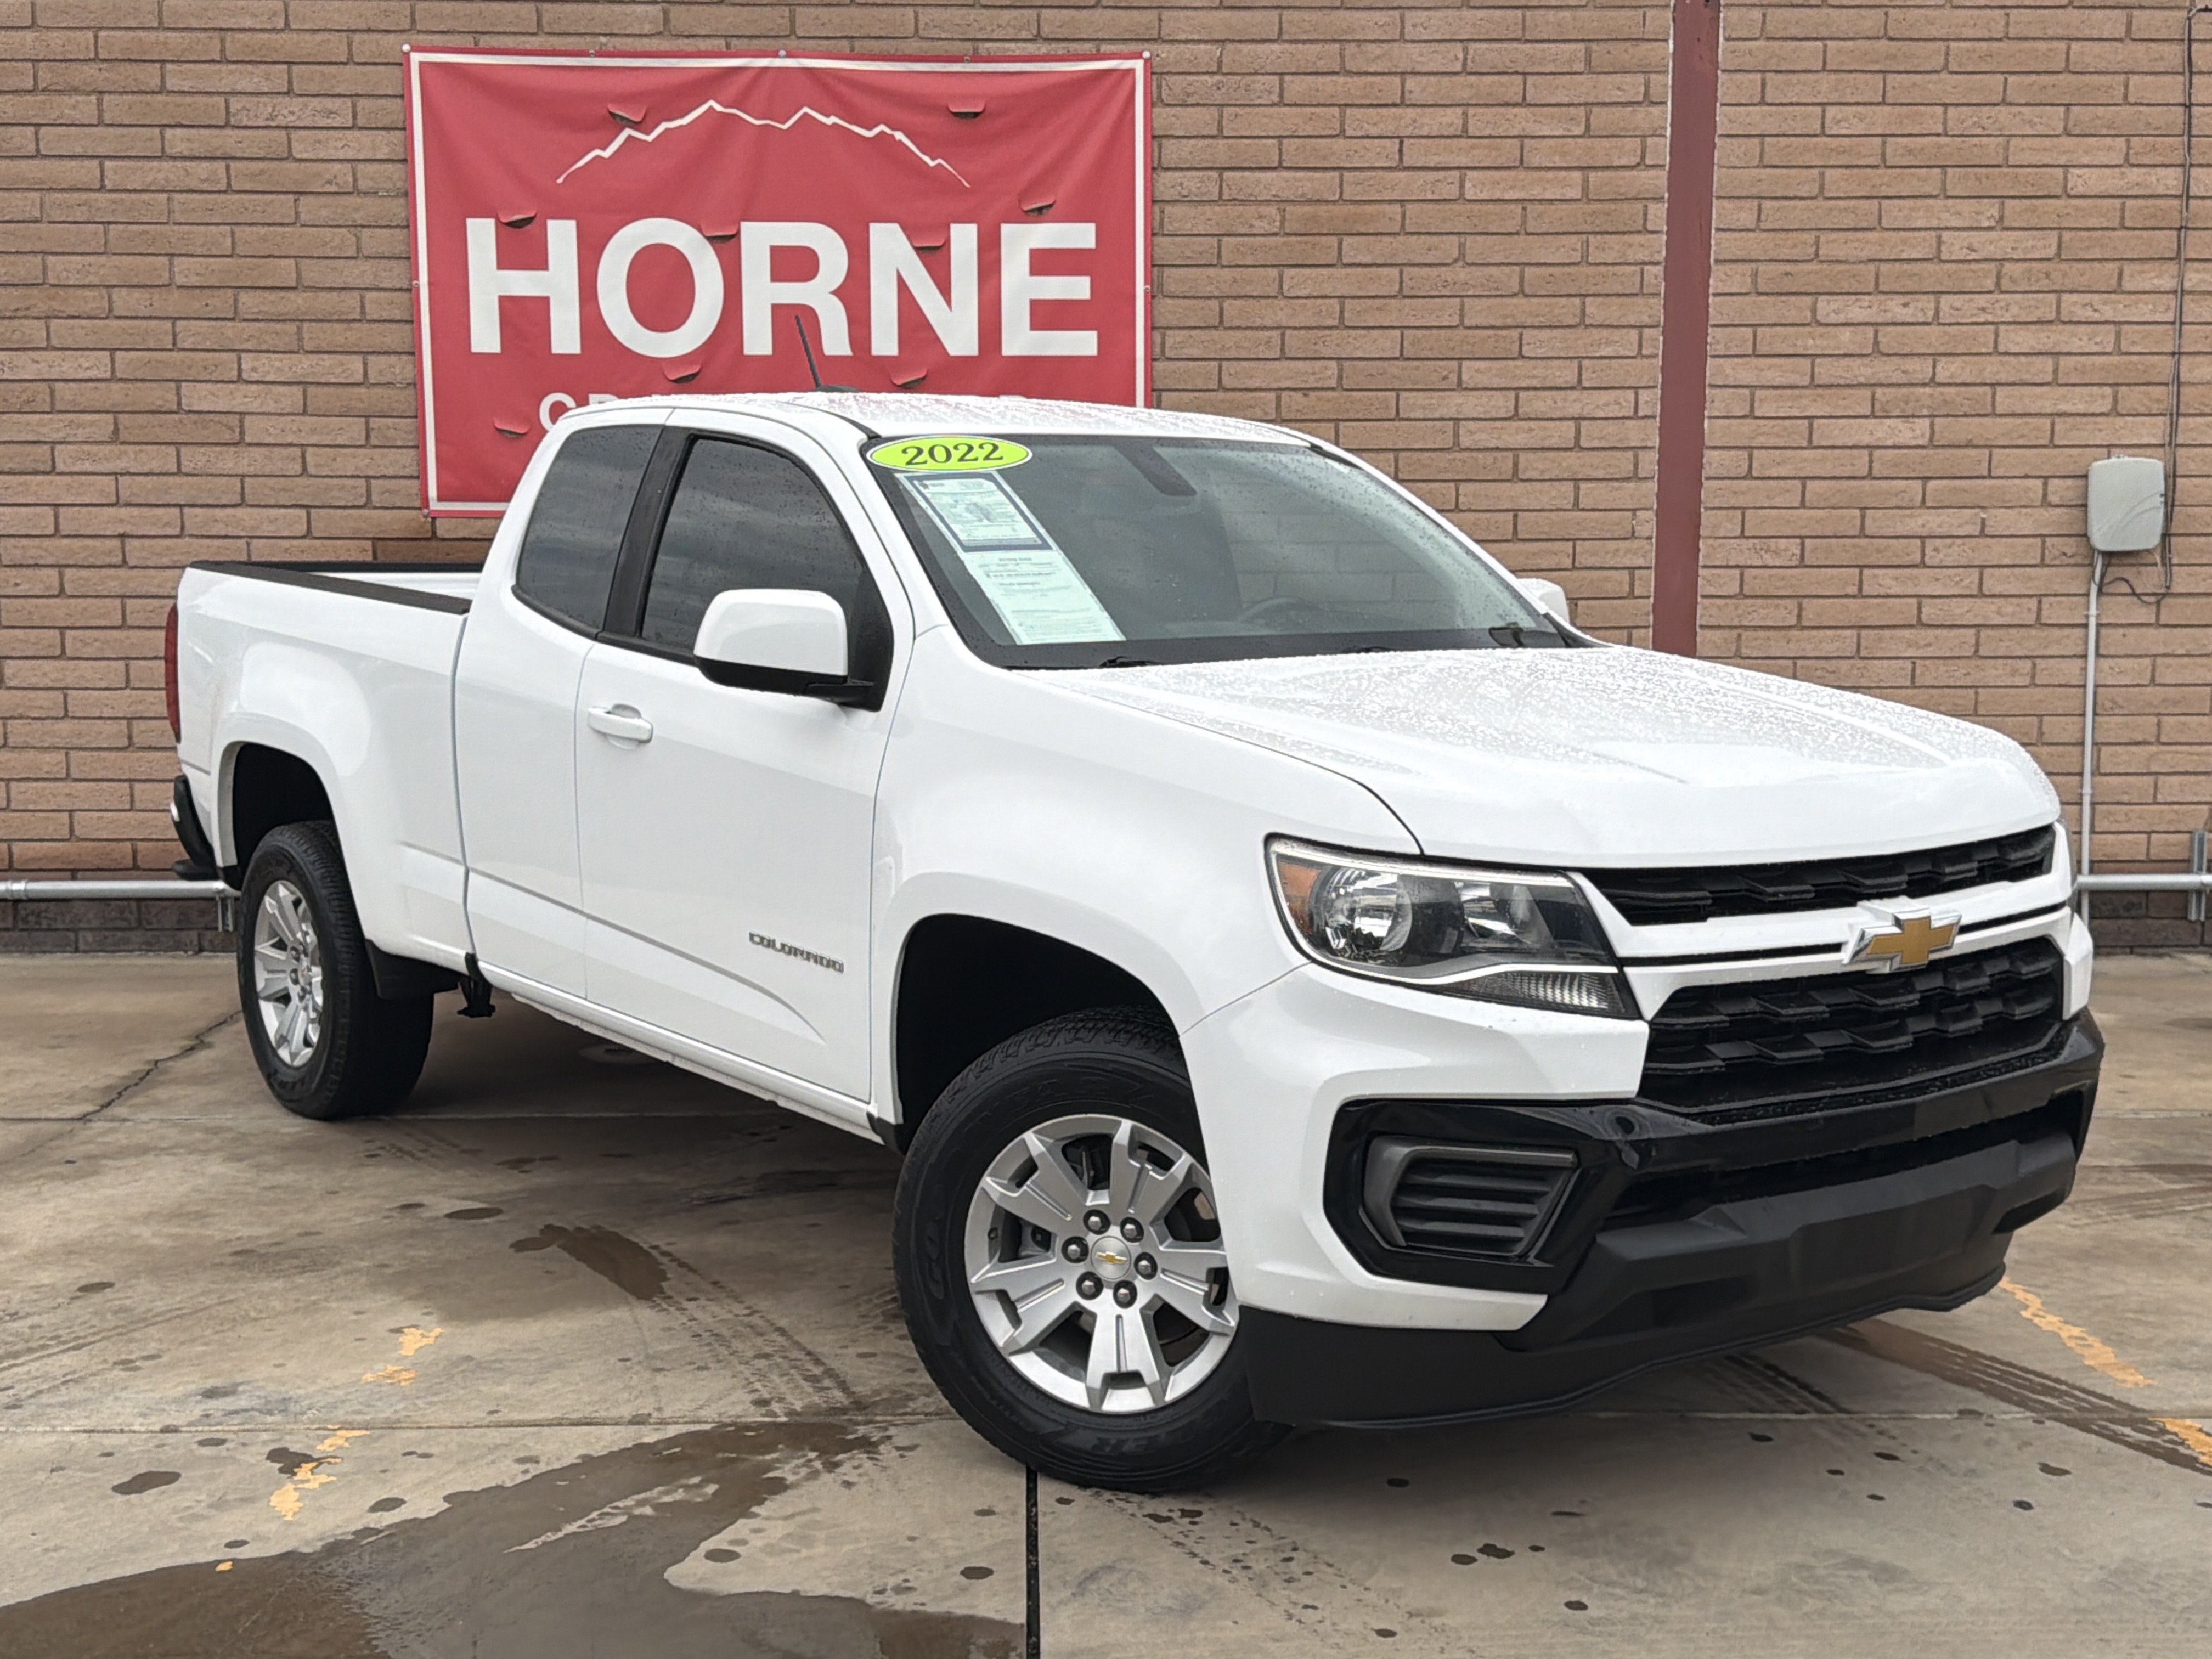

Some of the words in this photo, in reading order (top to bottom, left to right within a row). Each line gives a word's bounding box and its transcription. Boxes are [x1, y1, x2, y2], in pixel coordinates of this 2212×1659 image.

[466, 218, 1098, 358] HORNE
[901, 442, 1003, 466] 2022
[749, 932, 844, 973] COLORADO
